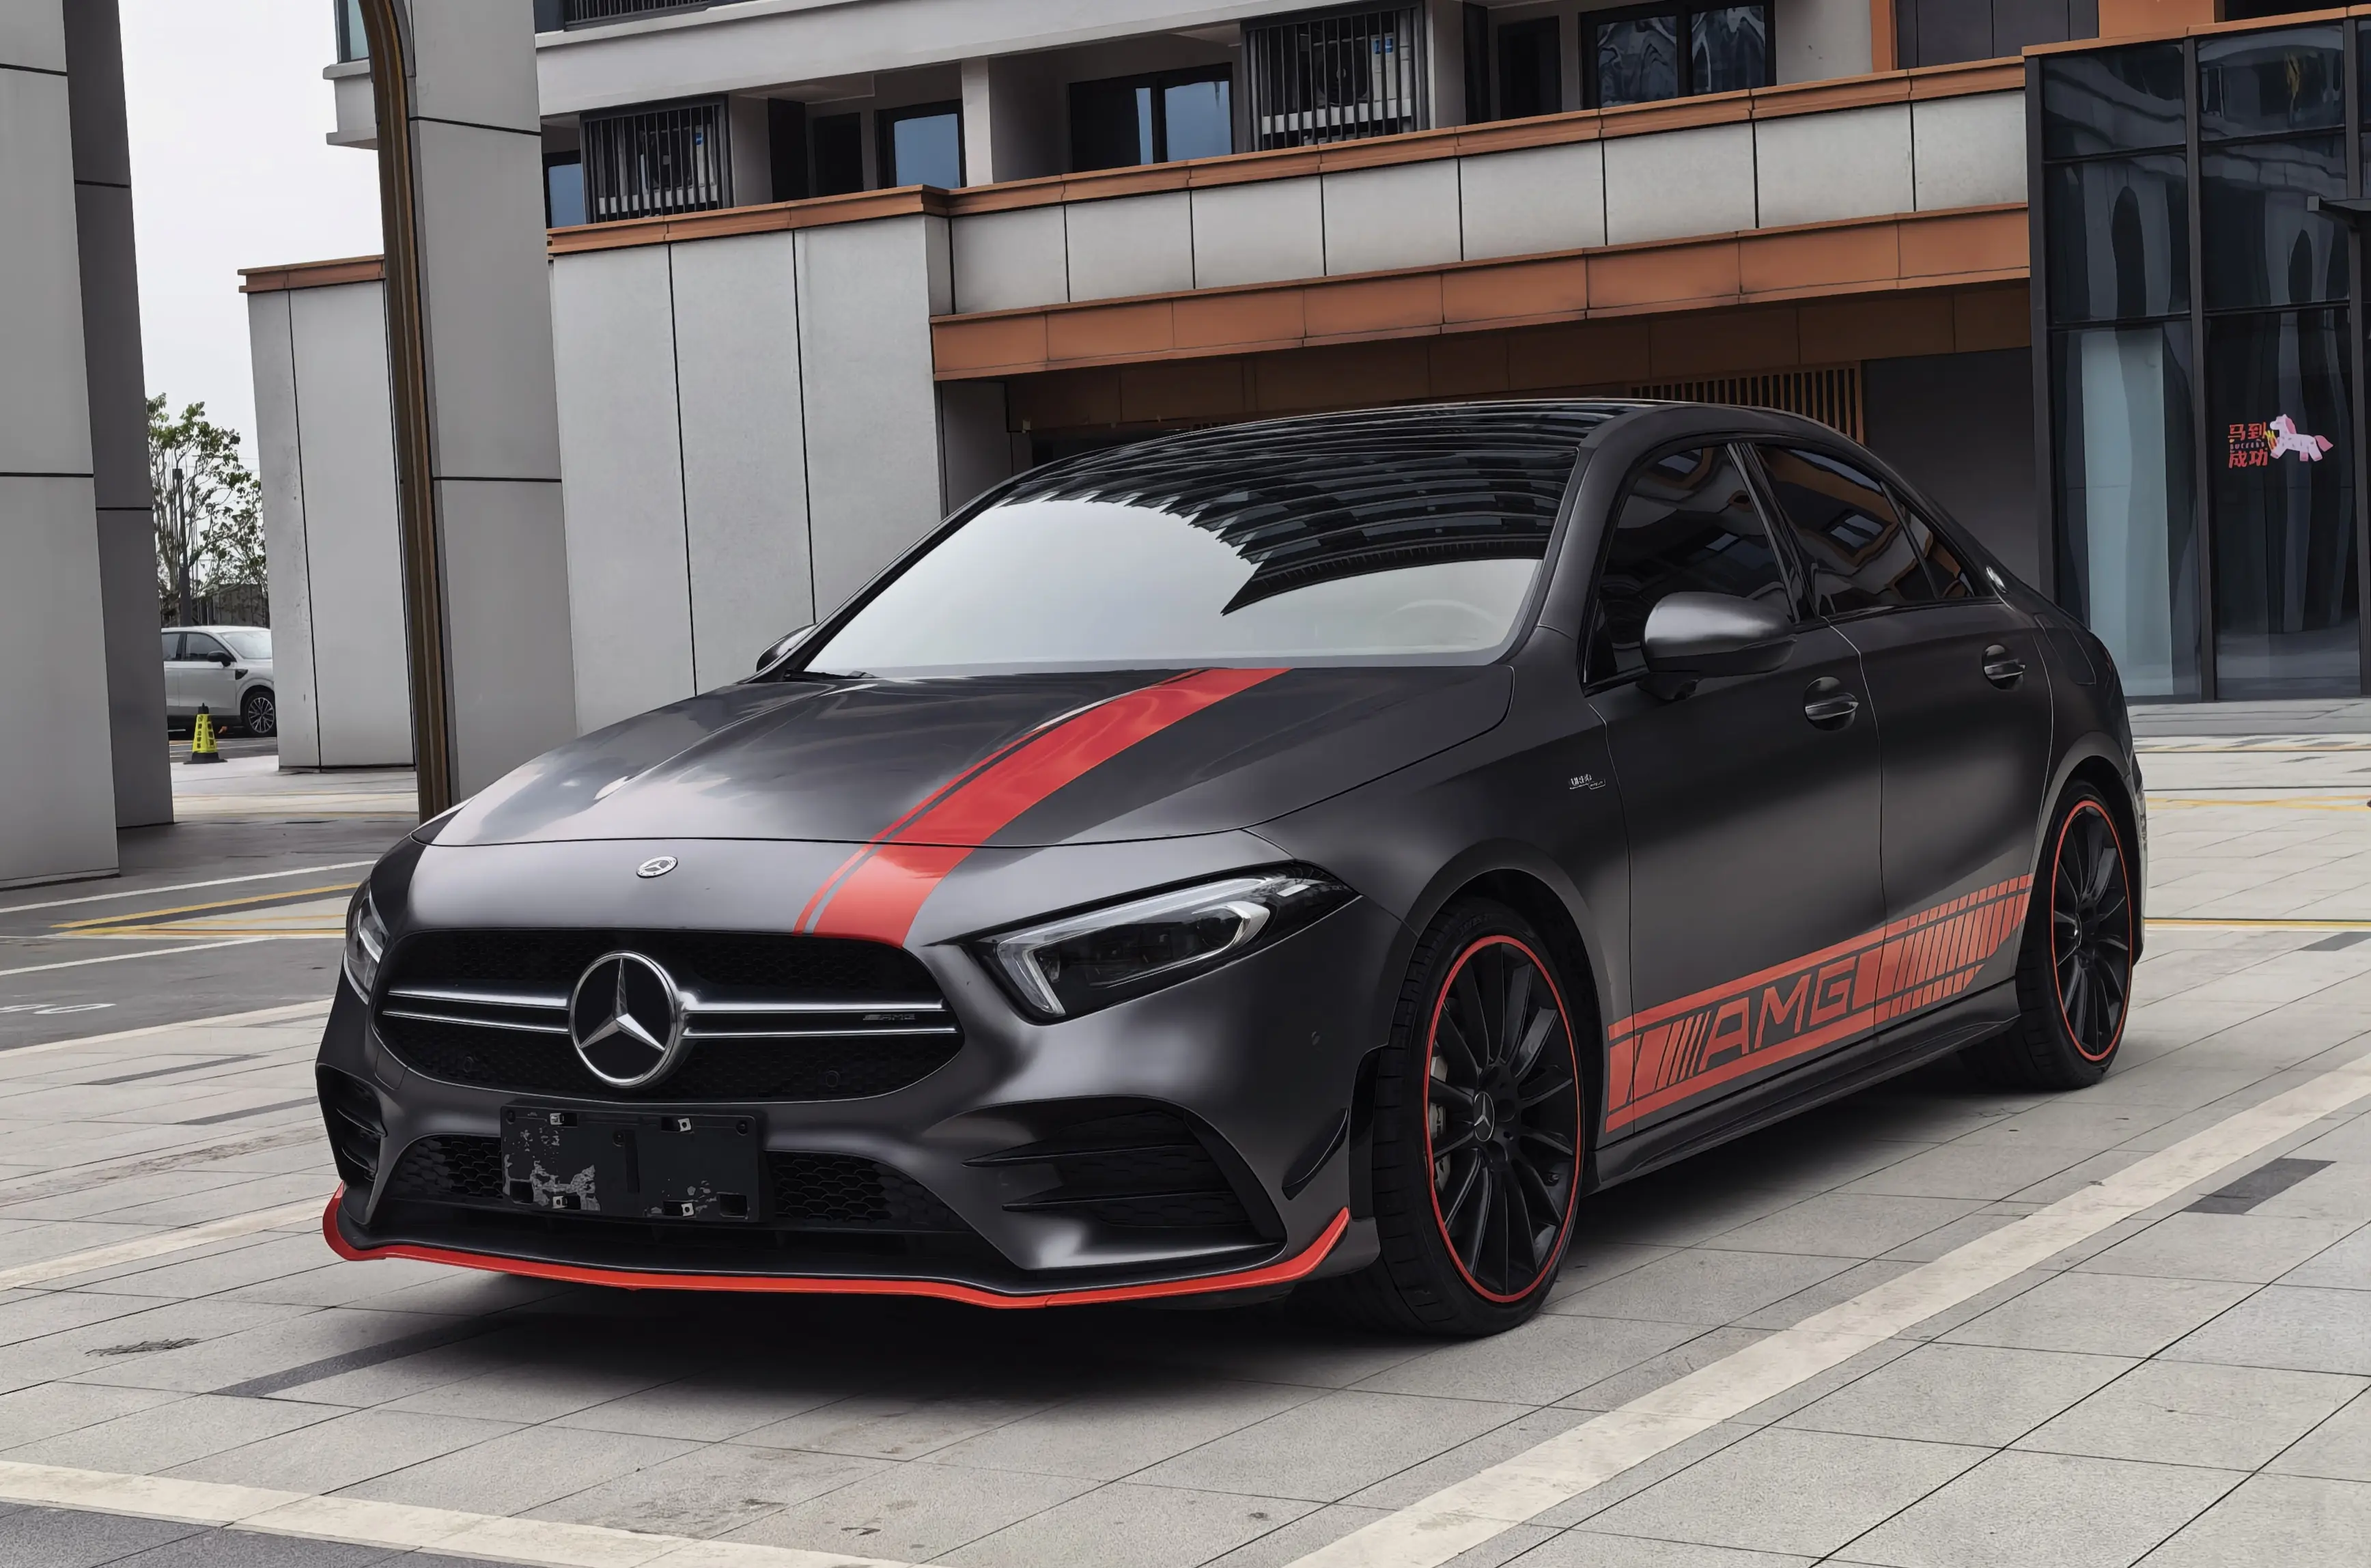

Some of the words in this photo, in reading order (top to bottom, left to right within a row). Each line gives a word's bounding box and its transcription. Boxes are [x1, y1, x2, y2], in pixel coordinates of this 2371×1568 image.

[2228, 422, 2267, 440] 马到
[2229, 449, 2269, 468] 成功
[1697, 955, 1856, 1073] AMG
